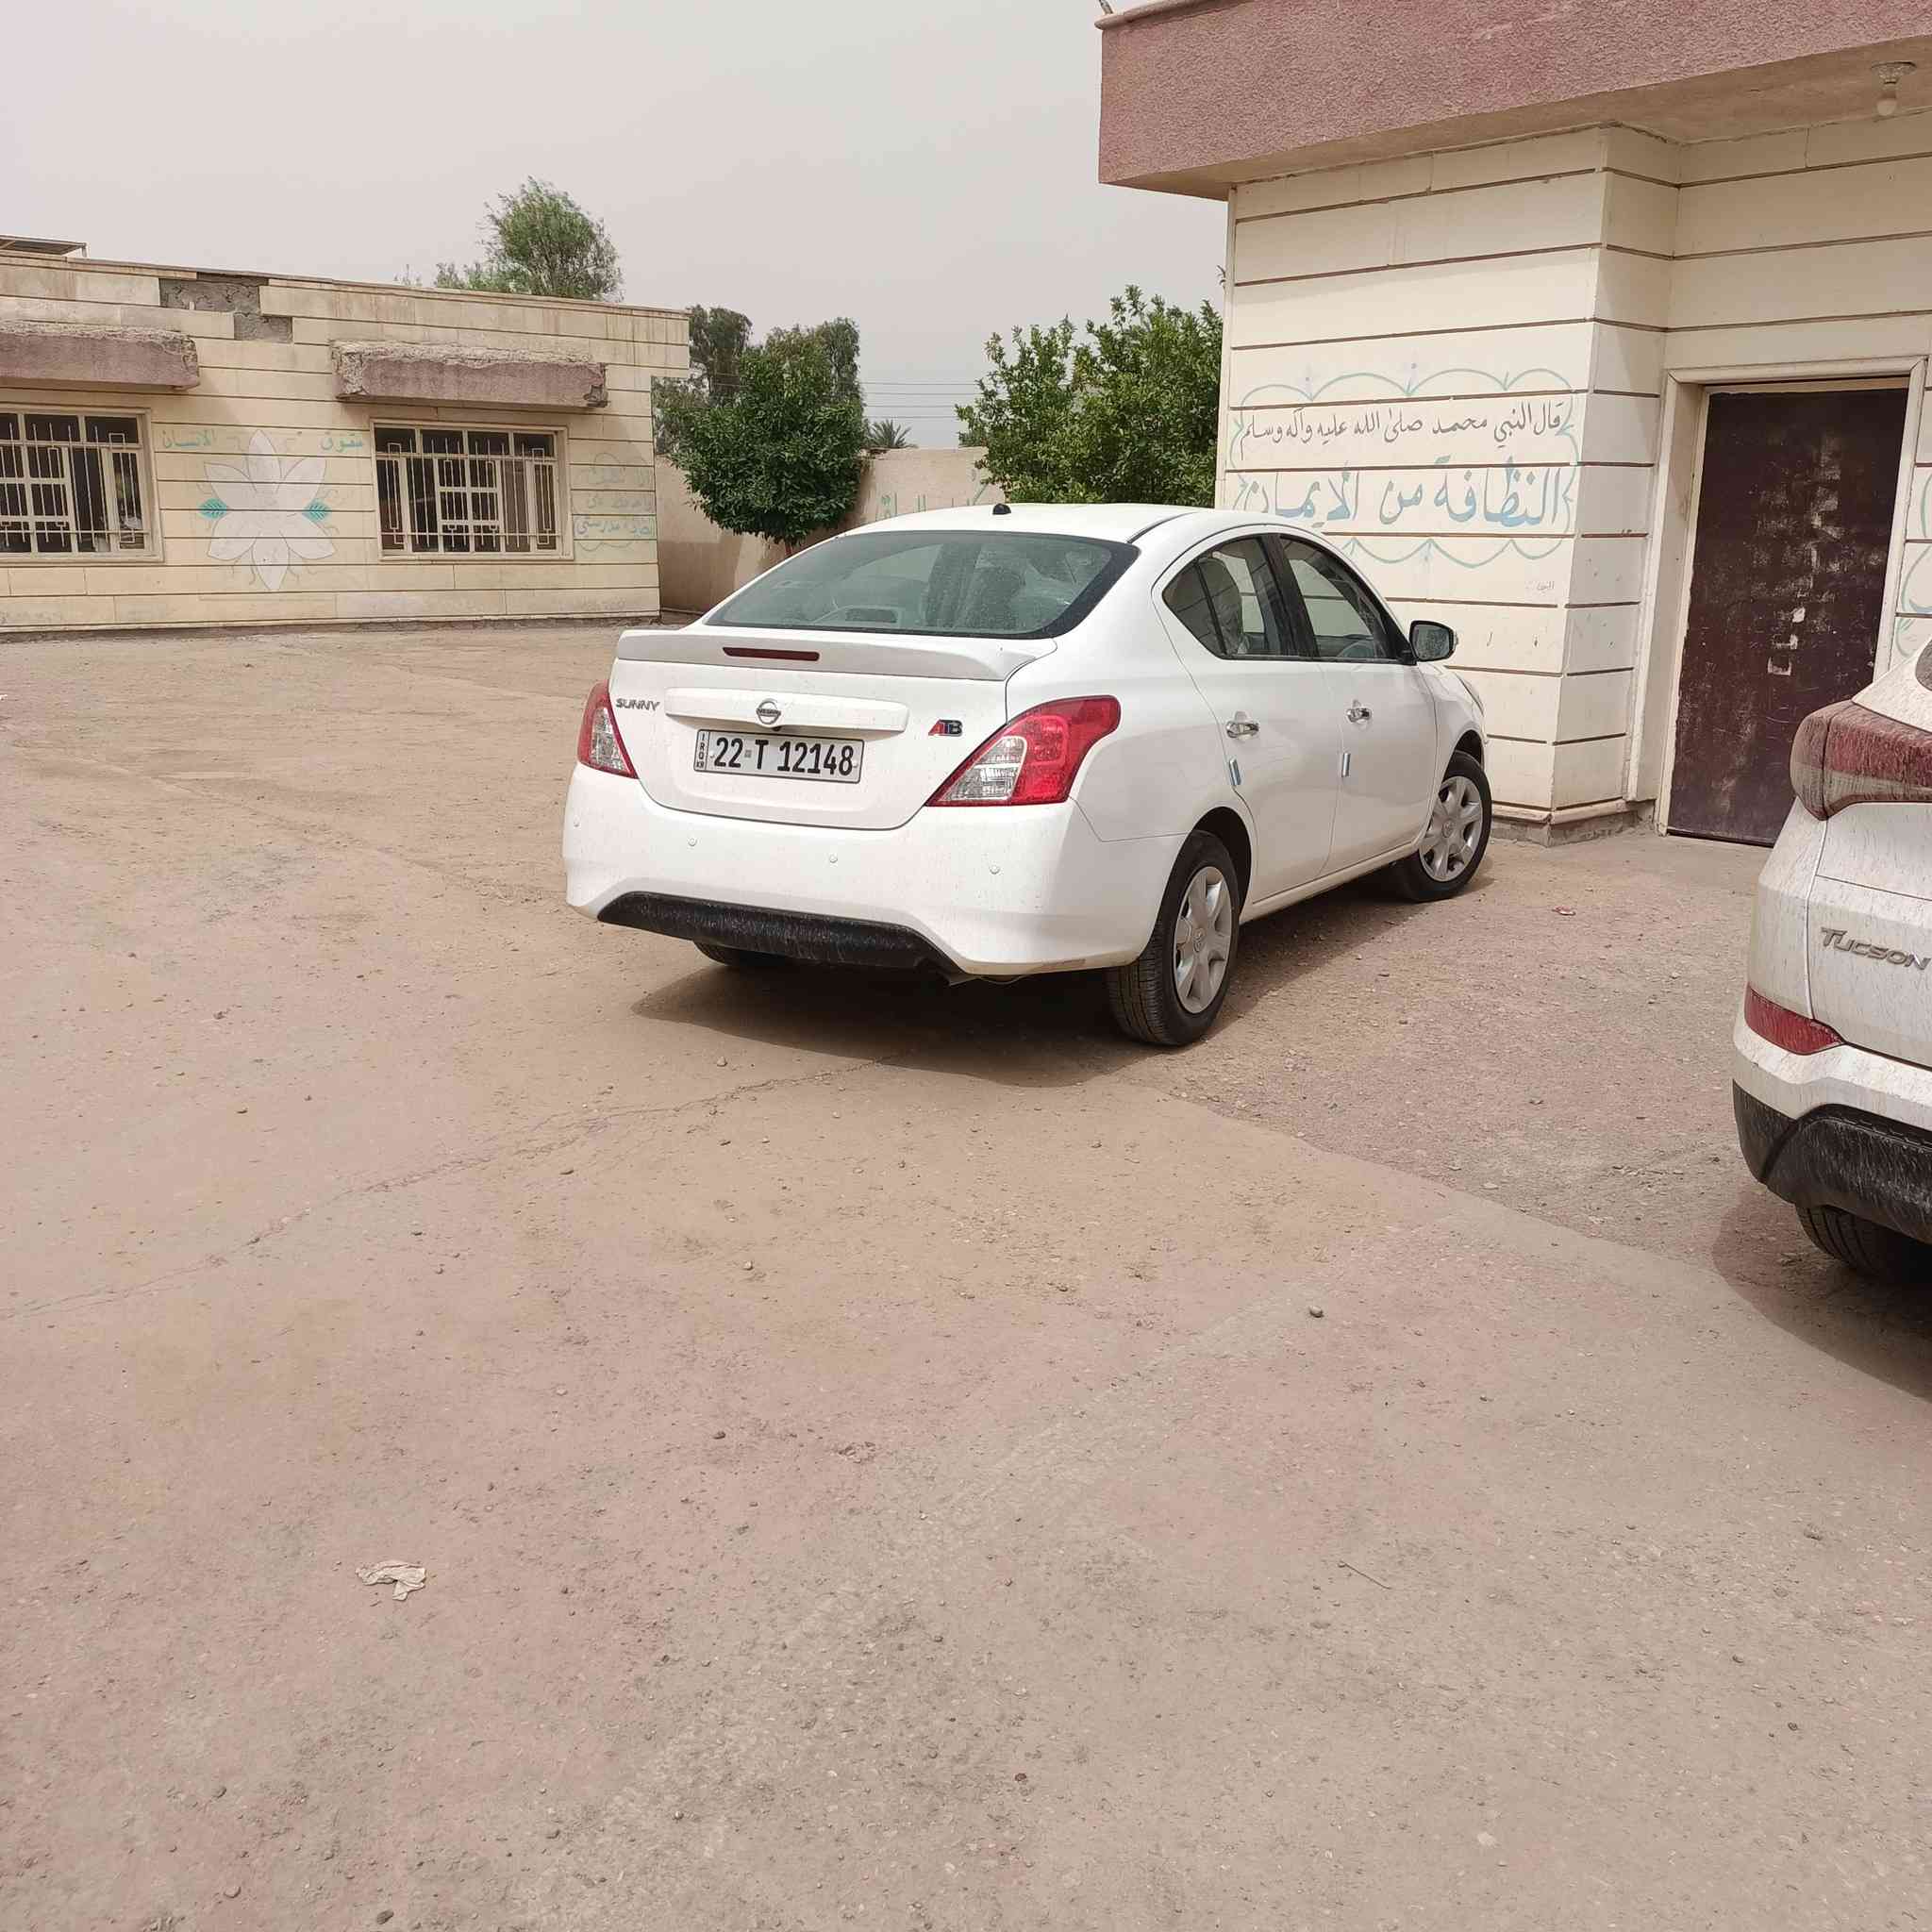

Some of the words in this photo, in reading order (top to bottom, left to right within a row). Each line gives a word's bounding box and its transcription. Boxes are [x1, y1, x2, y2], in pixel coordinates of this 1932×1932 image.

[1240, 414, 1283, 461] وسلم
[1317, 413, 1348, 446] عليه
[1354, 409, 1381, 434] الله
[1432, 413, 1488, 435] محمد
[1493, 400, 1533, 450] النبي
[1533, 400, 1565, 436] قال
[1379, 480, 1424, 525] من
[1433, 454, 1561, 528] النظافة
[615, 697, 660, 711] SUNNY
[714, 737, 743, 768] 22
[755, 739, 769, 770] T
[776, 741, 854, 776] 12148
[1820, 926, 1932, 971] TUCSON
